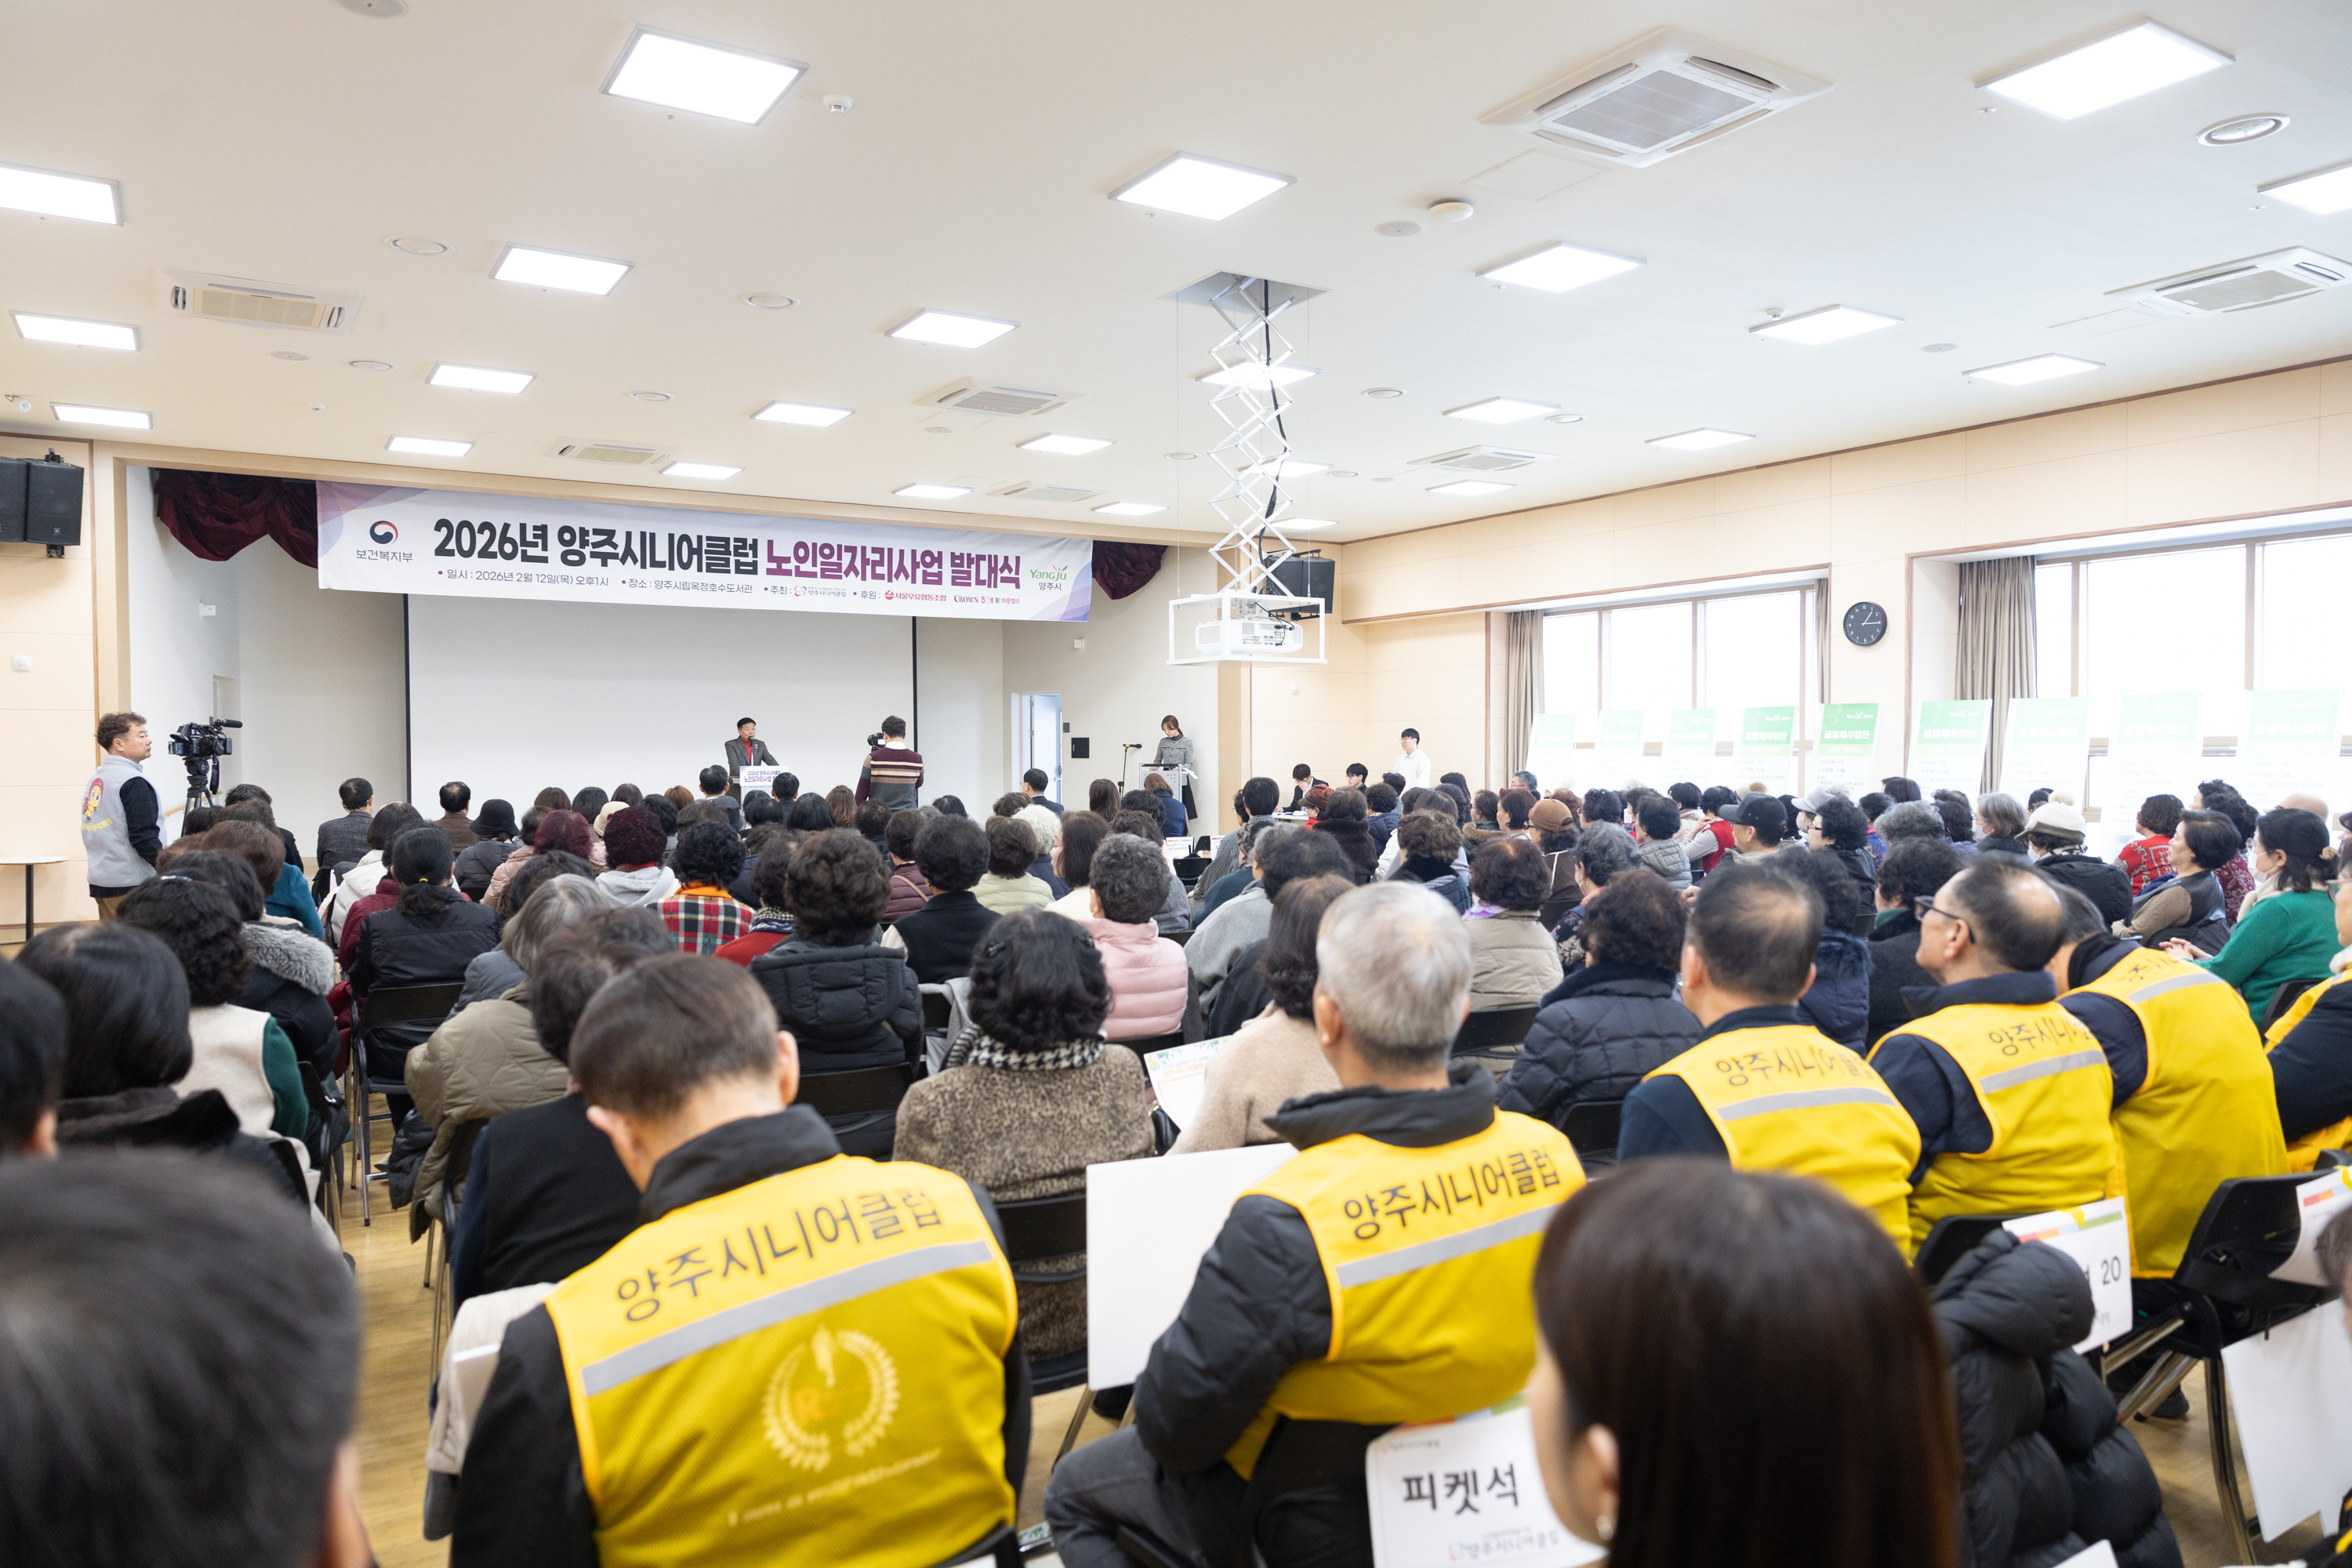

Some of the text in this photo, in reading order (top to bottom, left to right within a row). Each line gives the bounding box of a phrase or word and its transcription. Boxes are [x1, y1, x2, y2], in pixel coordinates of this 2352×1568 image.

[356, 549, 413, 563] 보건복지부
[434, 518, 1021, 589] 2026년 양주시니어클럽 노인일자리사업 발대식
[447, 568, 468, 579] 일시
[475, 570, 514, 582] 2026년
[516, 572, 533, 583] 2월
[536, 573, 573, 585] 12일(목)
[575, 575, 608, 586] 오후1시
[628, 579, 648, 589] 장소
[654, 579, 753, 594] 양주시립옥정호수도서관
[770, 586, 788, 595] 주최
[1039, 582, 1062, 591] 양주시
[860, 590, 877, 600] 후원
[895, 592, 947, 602] 서울우유협동조합
[953, 594, 979, 604] CROWN
[1824, 730, 1871, 740] 공동체사업단
[1343, 1146, 1560, 1241] 양주시니어클럽
[616, 1187, 942, 1323] 양주시니어클럽
[2100, 1256, 2122, 1286] 20
[1402, 1462, 1519, 1516] 피켓석
